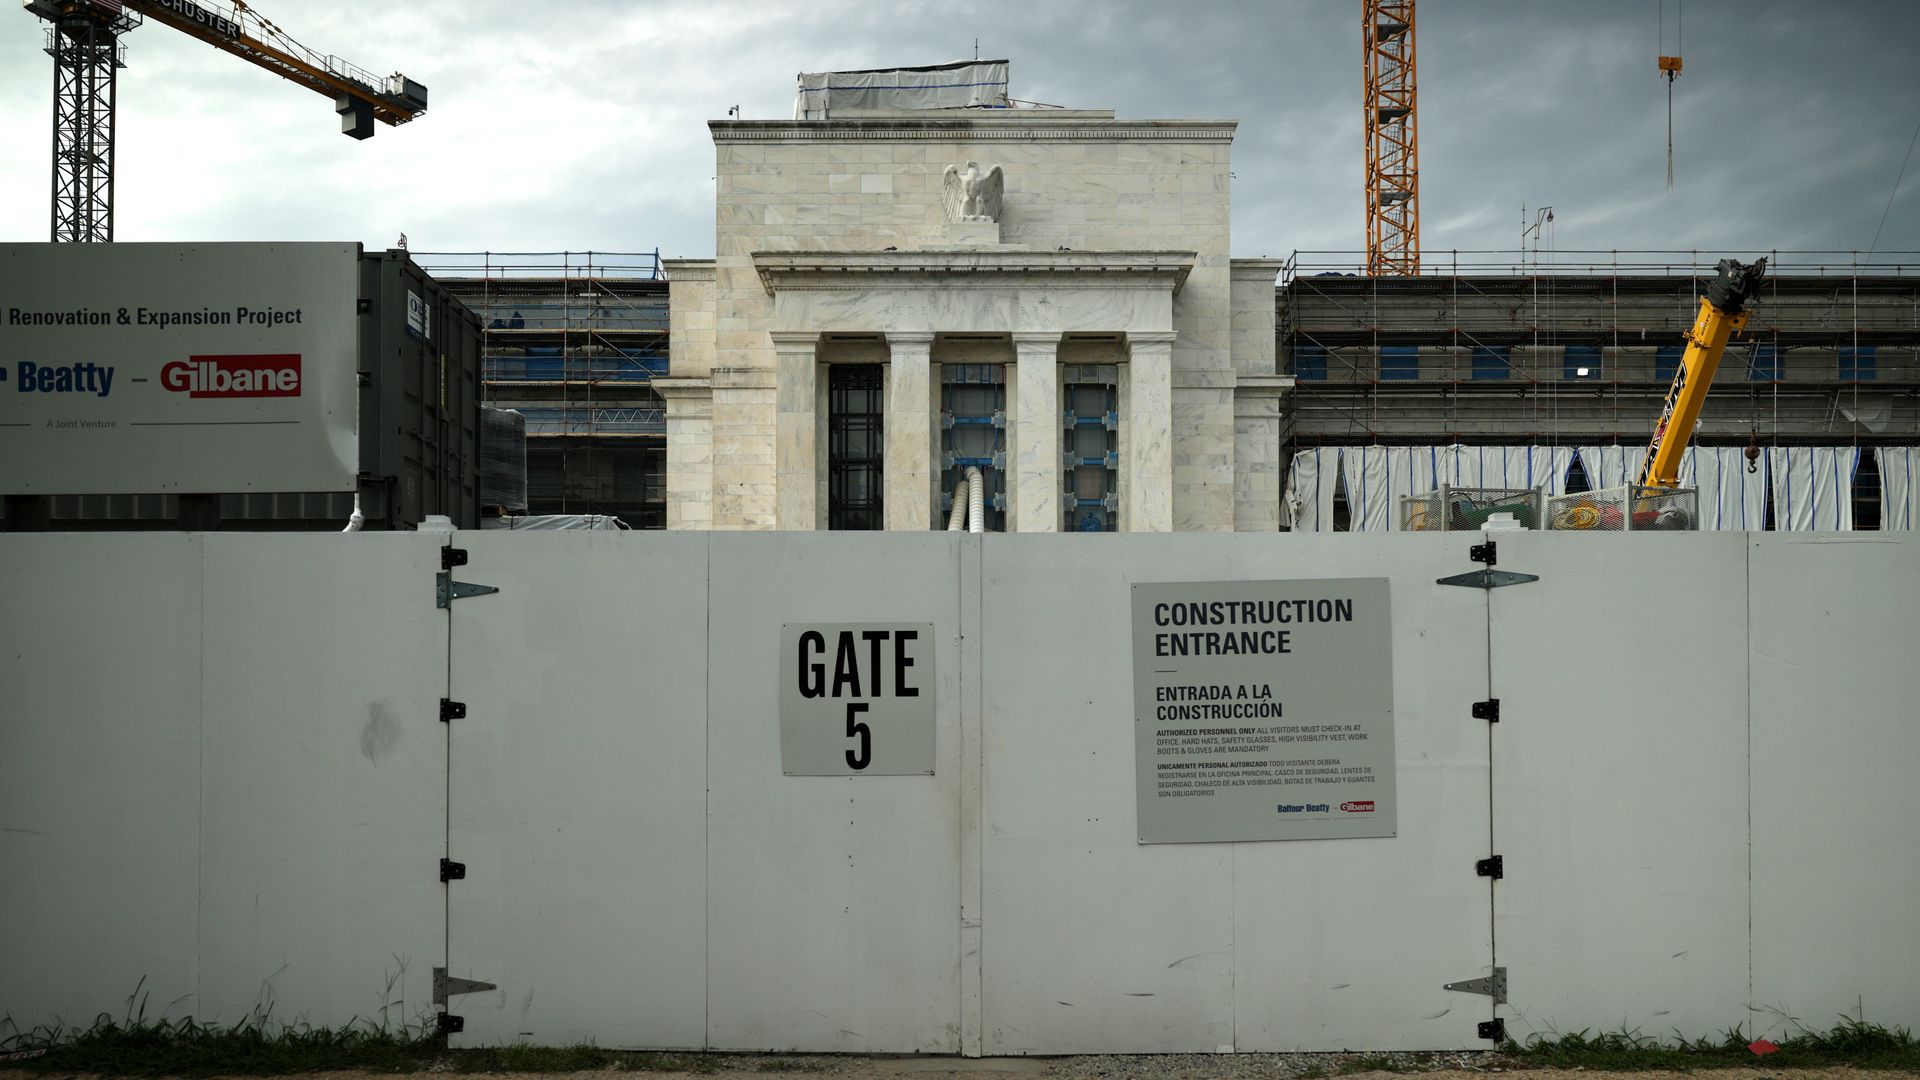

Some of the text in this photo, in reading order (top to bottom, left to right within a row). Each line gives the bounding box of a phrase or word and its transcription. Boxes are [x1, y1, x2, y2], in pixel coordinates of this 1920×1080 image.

[9, 308, 111, 325] Renovation
[116, 308, 131, 325] &
[137, 307, 231, 329] Expansion
[236, 307, 302, 328] Project
[17, 361, 114, 397] Beatty
[160, 357, 301, 396] Gilbane
[46, 419, 117, 429] A Joint Venture
[1154, 598, 1353, 626] CONSTRUCTION
[1155, 630, 1292, 657] ENTRANCE
[798, 630, 919, 699] GATE
[1156, 684, 1272, 702] ENTRADA A LA
[1156, 699, 1283, 721] CONSTRUCCIÓN
[845, 703, 871, 770] 5
[1269, 726, 1300, 734] VISITORS
[1300, 725, 1320, 733] MUST
[1221, 736, 1245, 744] SAFETY
[1279, 735, 1295, 743] HIGH
[1296, 734, 1329, 742] VISIBILITY
[1157, 747, 1179, 755] BOOTS
[1180, 747, 1186, 755] &
[1187, 746, 1213, 754] GLOVES
[1228, 745, 1269, 753] MANDATORY
[1216, 770, 1240, 778] OFICINA
[1363, 766, 1372, 774] DE
[1222, 779, 1231, 787] DE
[1305, 777, 1313, 785] DE
[1172, 789, 1215, 797] OBLIGATORIOS
[1277, 803, 1330, 813] Balfour Beatty
[1340, 801, 1375, 812] Gilbane
